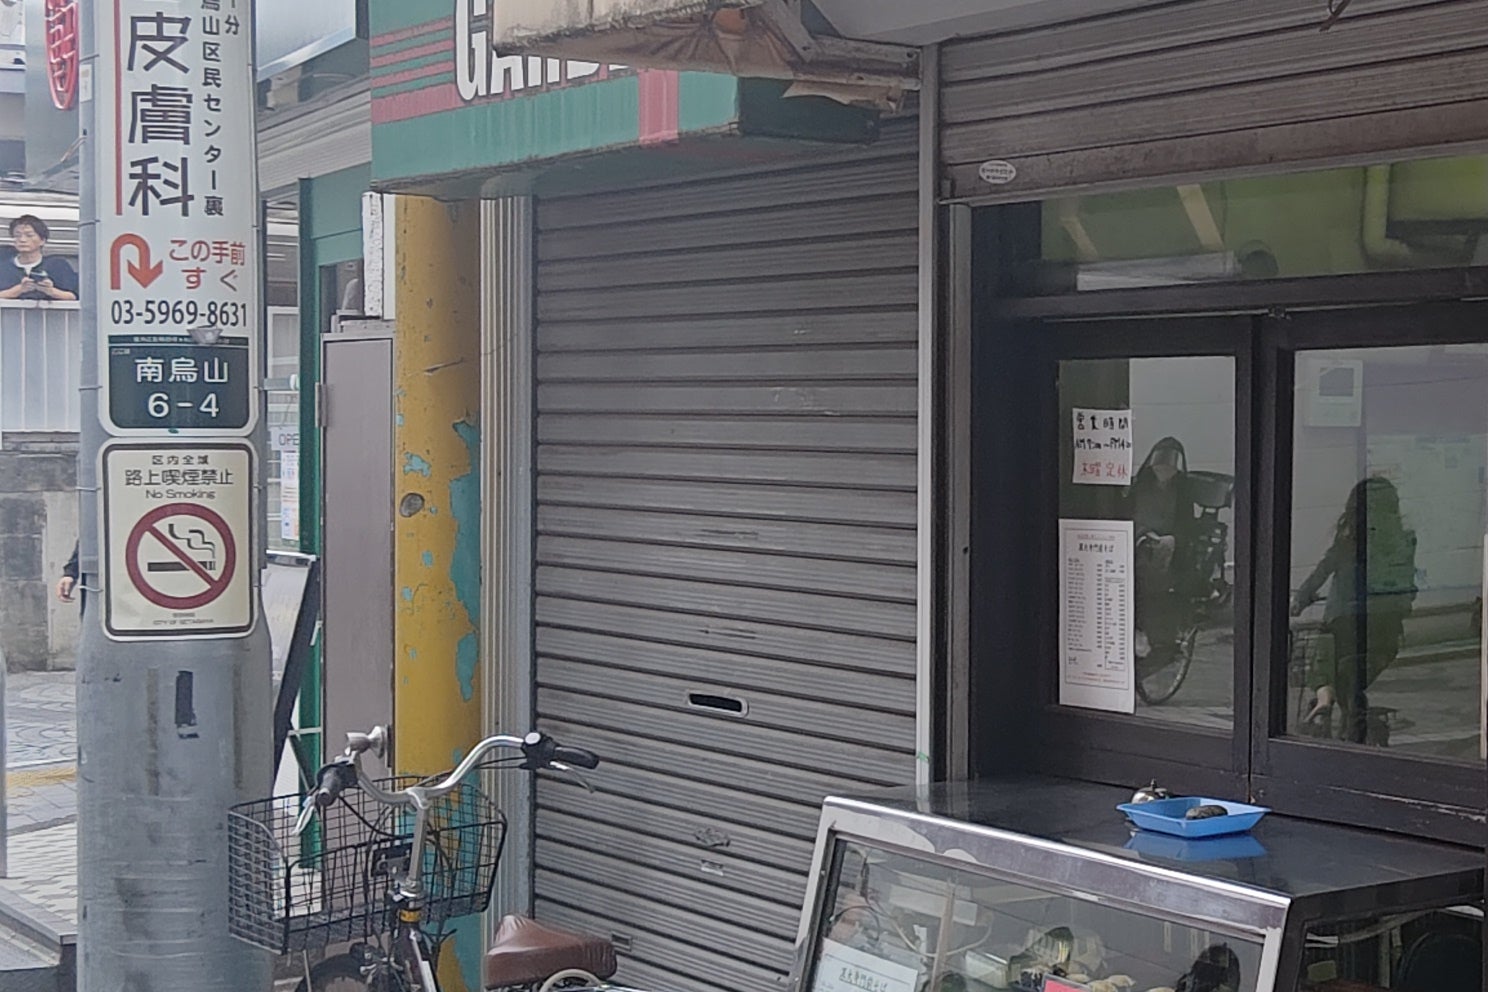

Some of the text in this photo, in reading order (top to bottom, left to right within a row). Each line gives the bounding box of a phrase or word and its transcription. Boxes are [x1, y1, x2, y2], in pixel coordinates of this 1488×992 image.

[127, 11, 195, 217] 皮膚科
[169, 238, 246, 266] この手前
[182, 267, 238, 291] すぐ
[111, 299, 248, 327] 03-5969-8631
[134, 356, 229, 383] 南烏山
[148, 393, 220, 418] 6-4
[152, 455, 209, 465] 区内全域
[125, 468, 234, 487] 路上喫煙禁止
[145, 488, 216, 500] No Smoking
